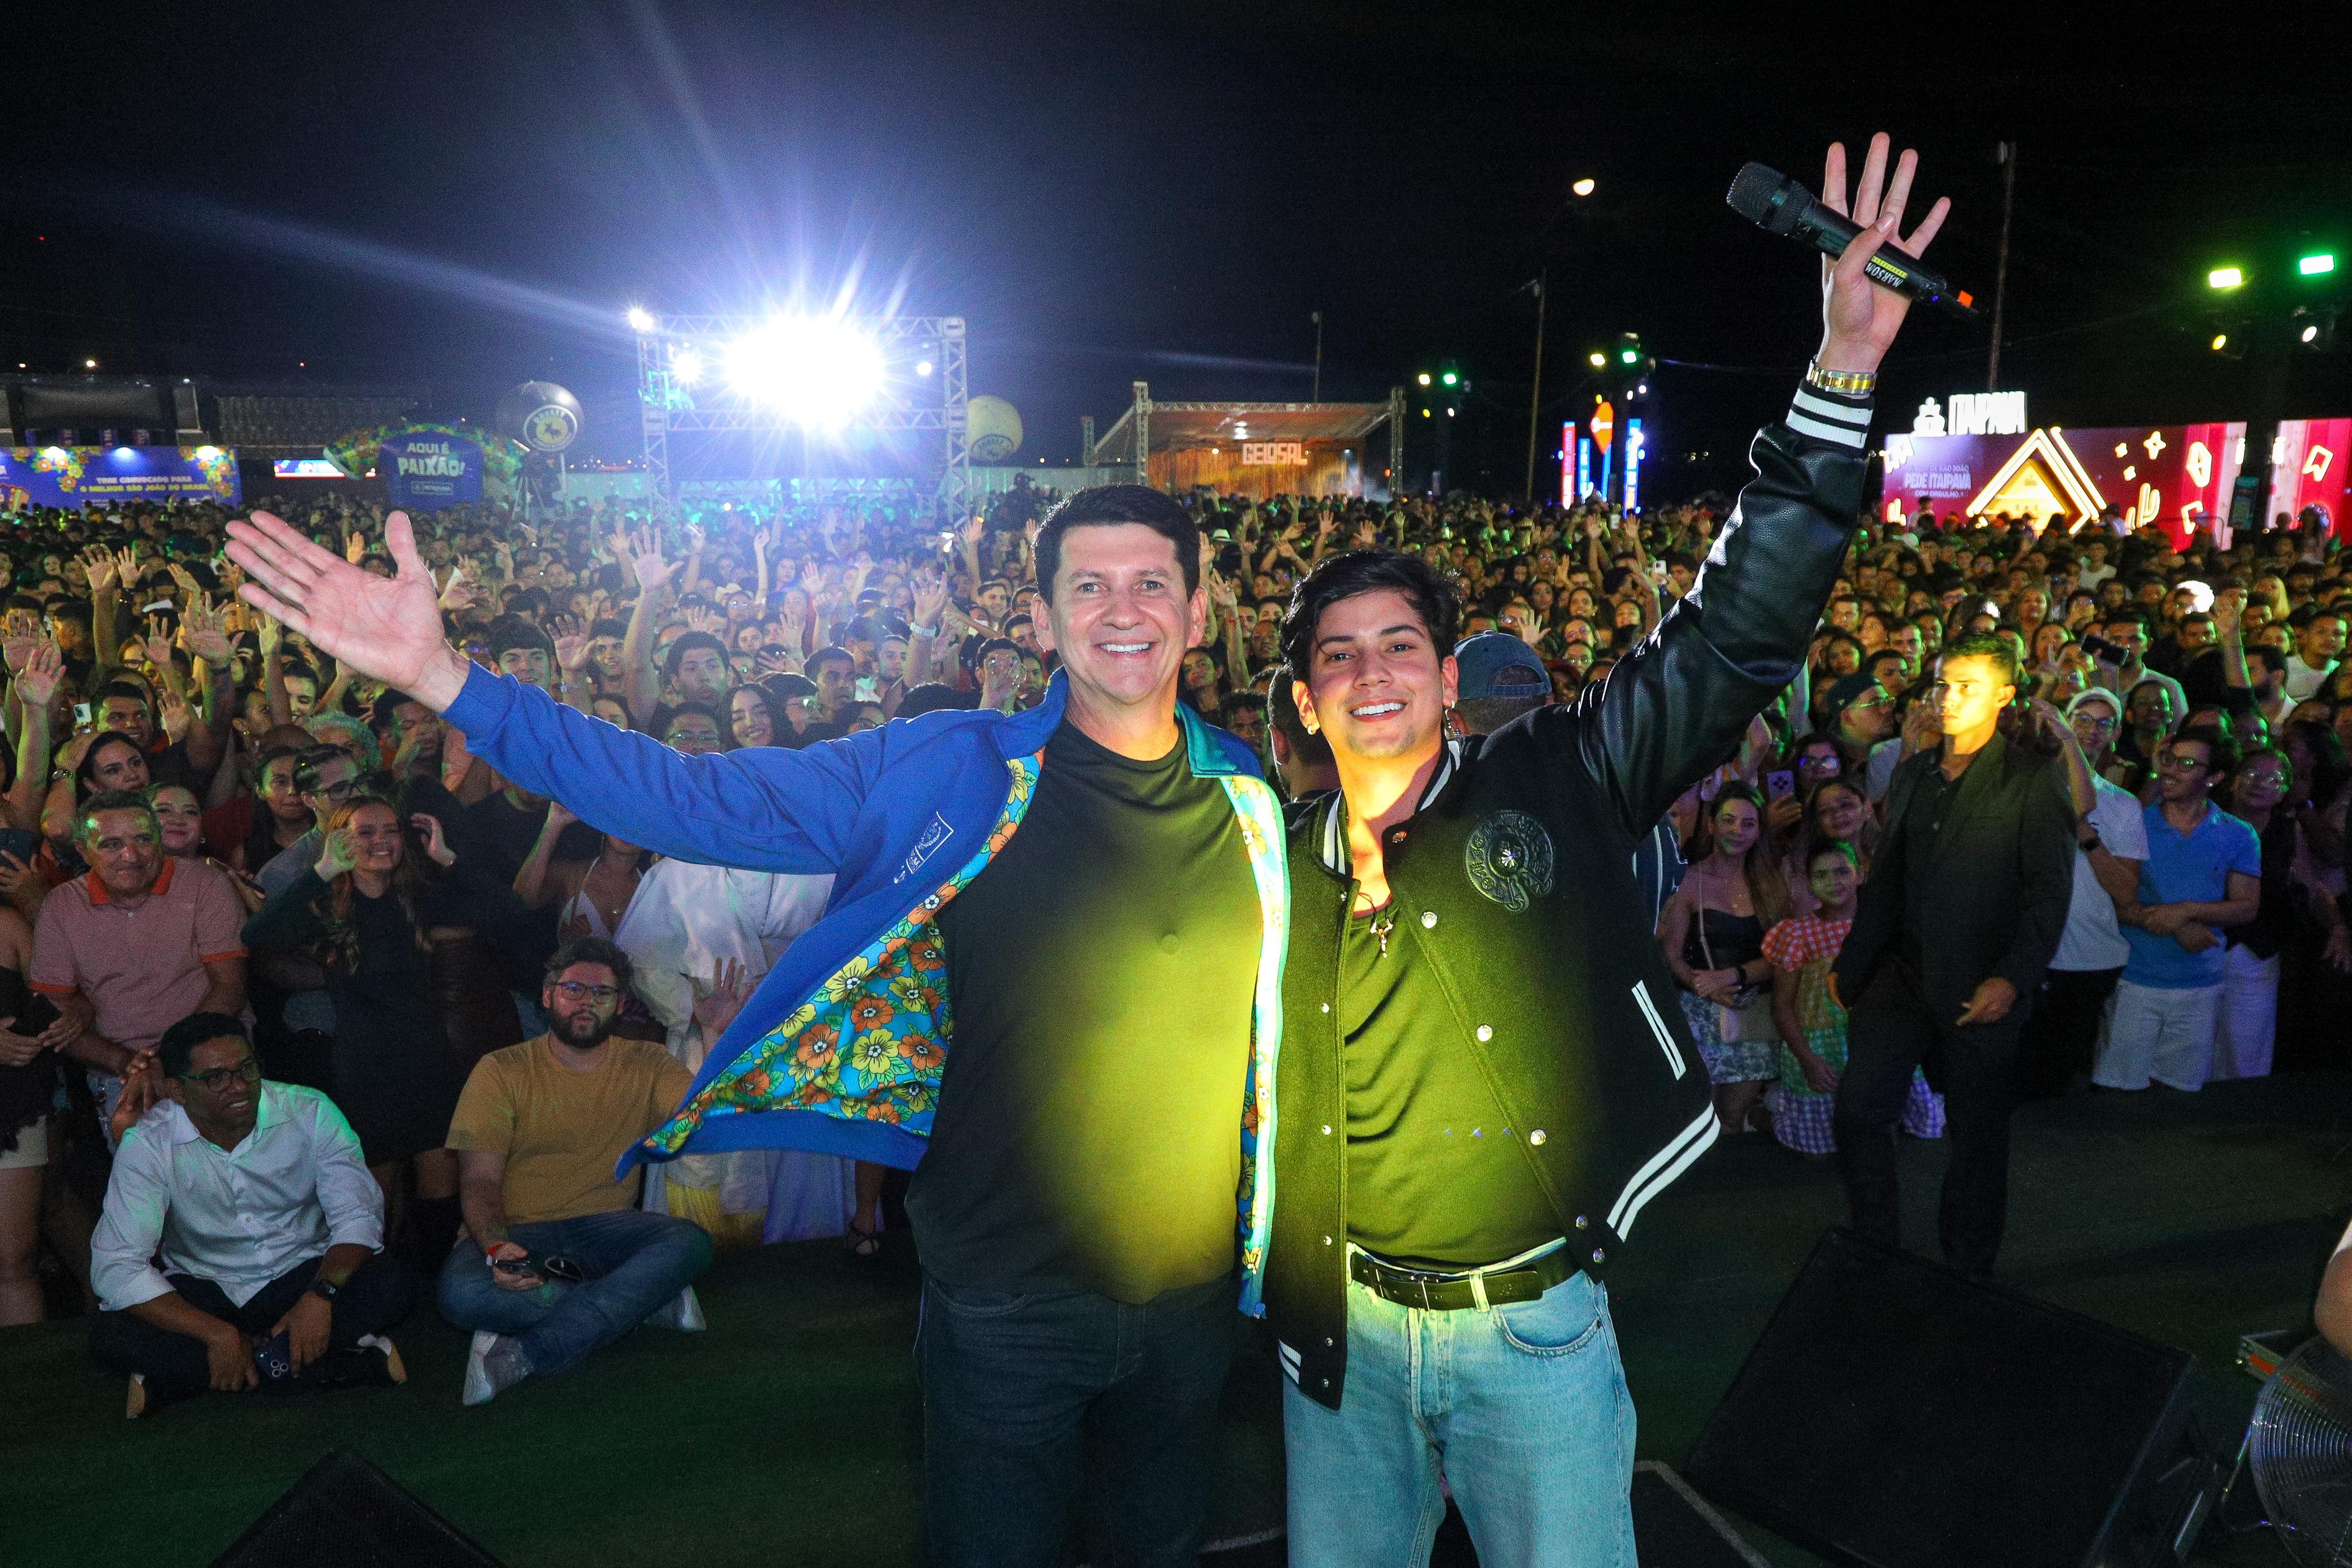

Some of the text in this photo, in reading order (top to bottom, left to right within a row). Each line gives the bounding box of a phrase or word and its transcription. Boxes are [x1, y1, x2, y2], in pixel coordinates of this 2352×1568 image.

[1865, 262, 1904, 287] MARSOM
[407, 443, 439, 453] AQUI
[1904, 472, 1971, 490] PEDE ITAIPAVA
